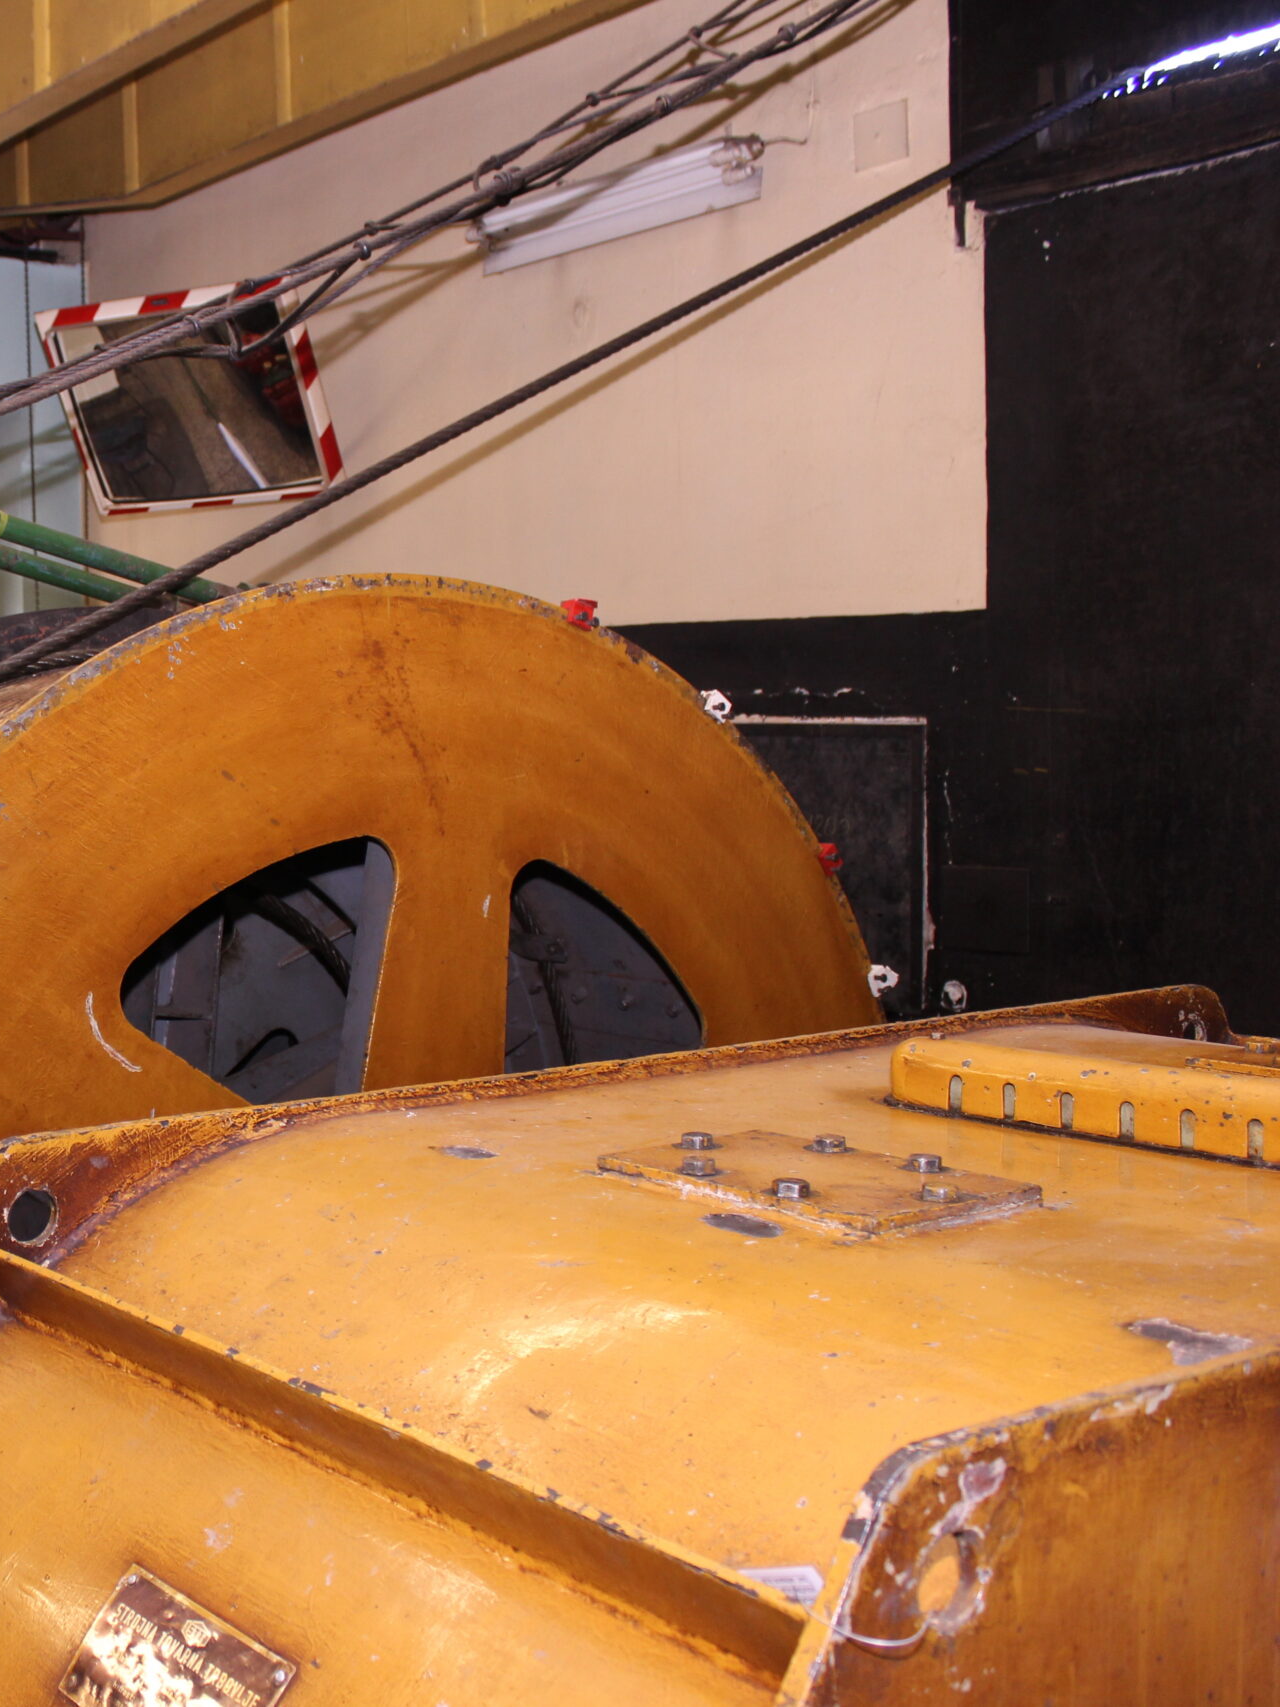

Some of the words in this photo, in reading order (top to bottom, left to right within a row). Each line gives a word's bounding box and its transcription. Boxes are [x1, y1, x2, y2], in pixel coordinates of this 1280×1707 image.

[115, 1603, 158, 1643] STROJNA
[159, 1631, 202, 1675] TOVARNA
[203, 1663, 261, 1707] TRBOVLJE
